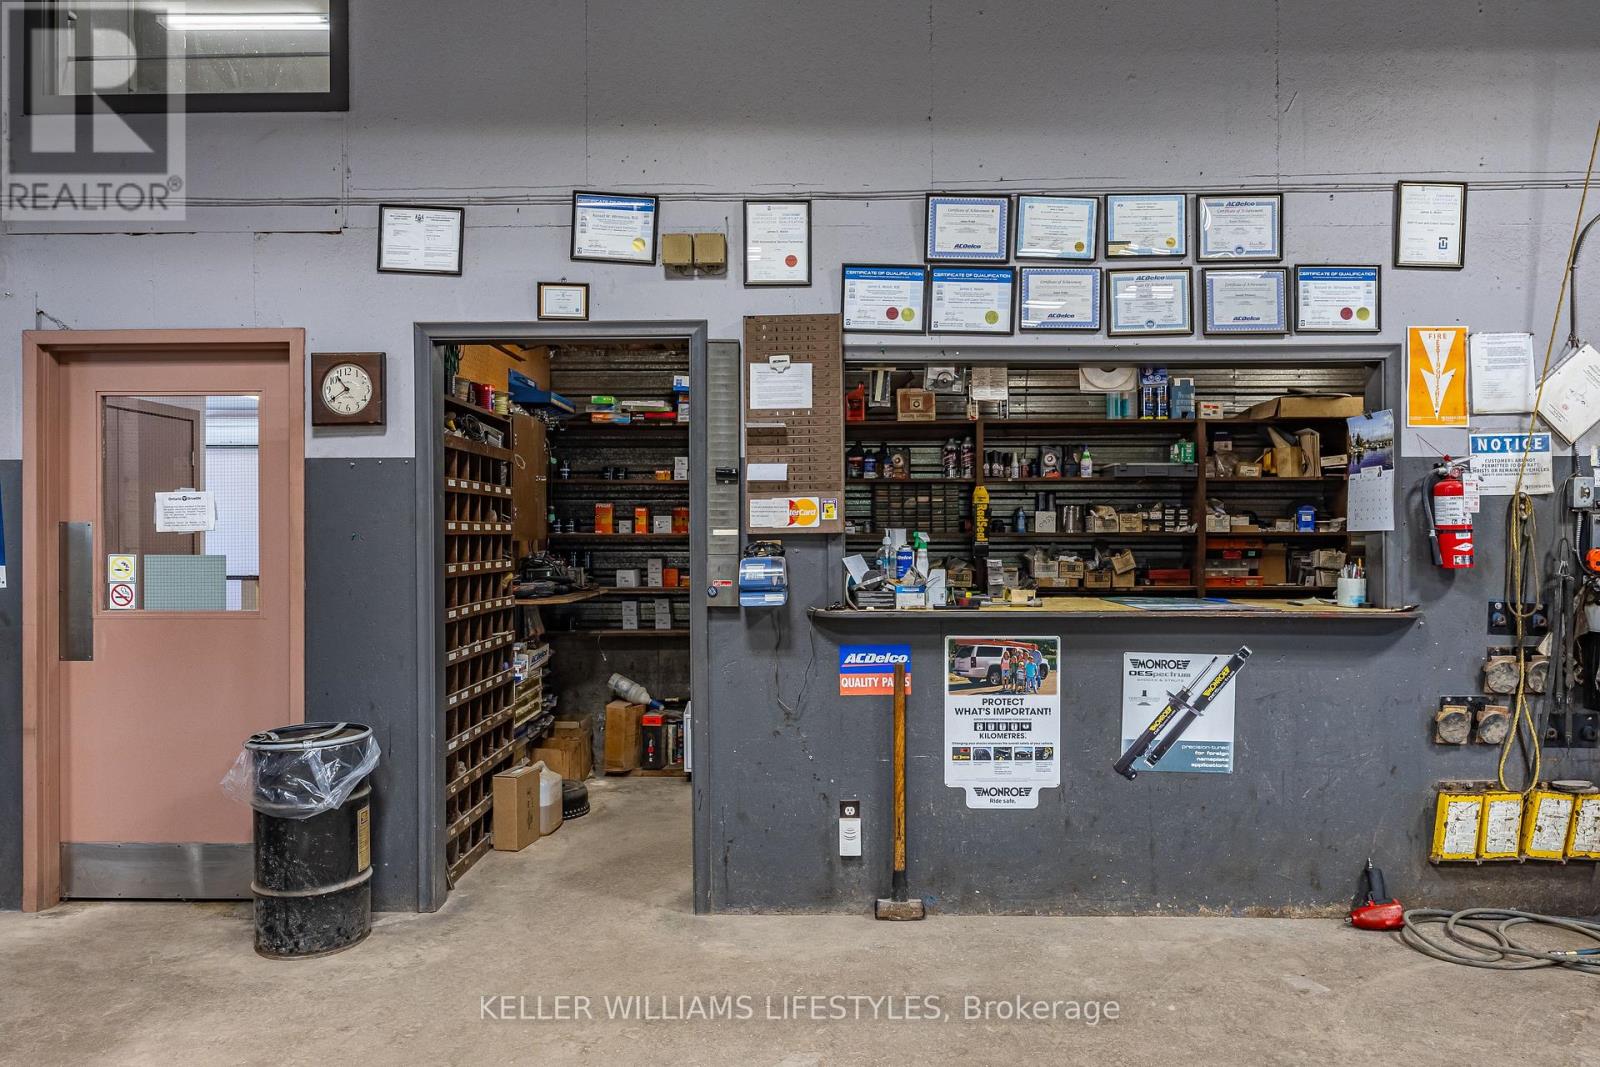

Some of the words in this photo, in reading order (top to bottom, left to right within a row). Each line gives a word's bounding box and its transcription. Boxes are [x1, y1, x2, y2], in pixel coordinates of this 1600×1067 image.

[1477, 437, 1543, 451] NOTICE
[844, 653, 908, 664] ACDelco
[1137, 659, 1182, 669] MONROE
[841, 677, 879, 688] QUALITY
[881, 677, 910, 688] PAS
[981, 698, 1025, 706] PROTECT
[954, 707, 991, 716] WHAT'S
[993, 707, 1052, 716] IMPORTANT!
[981, 787, 1025, 796] MONROE
